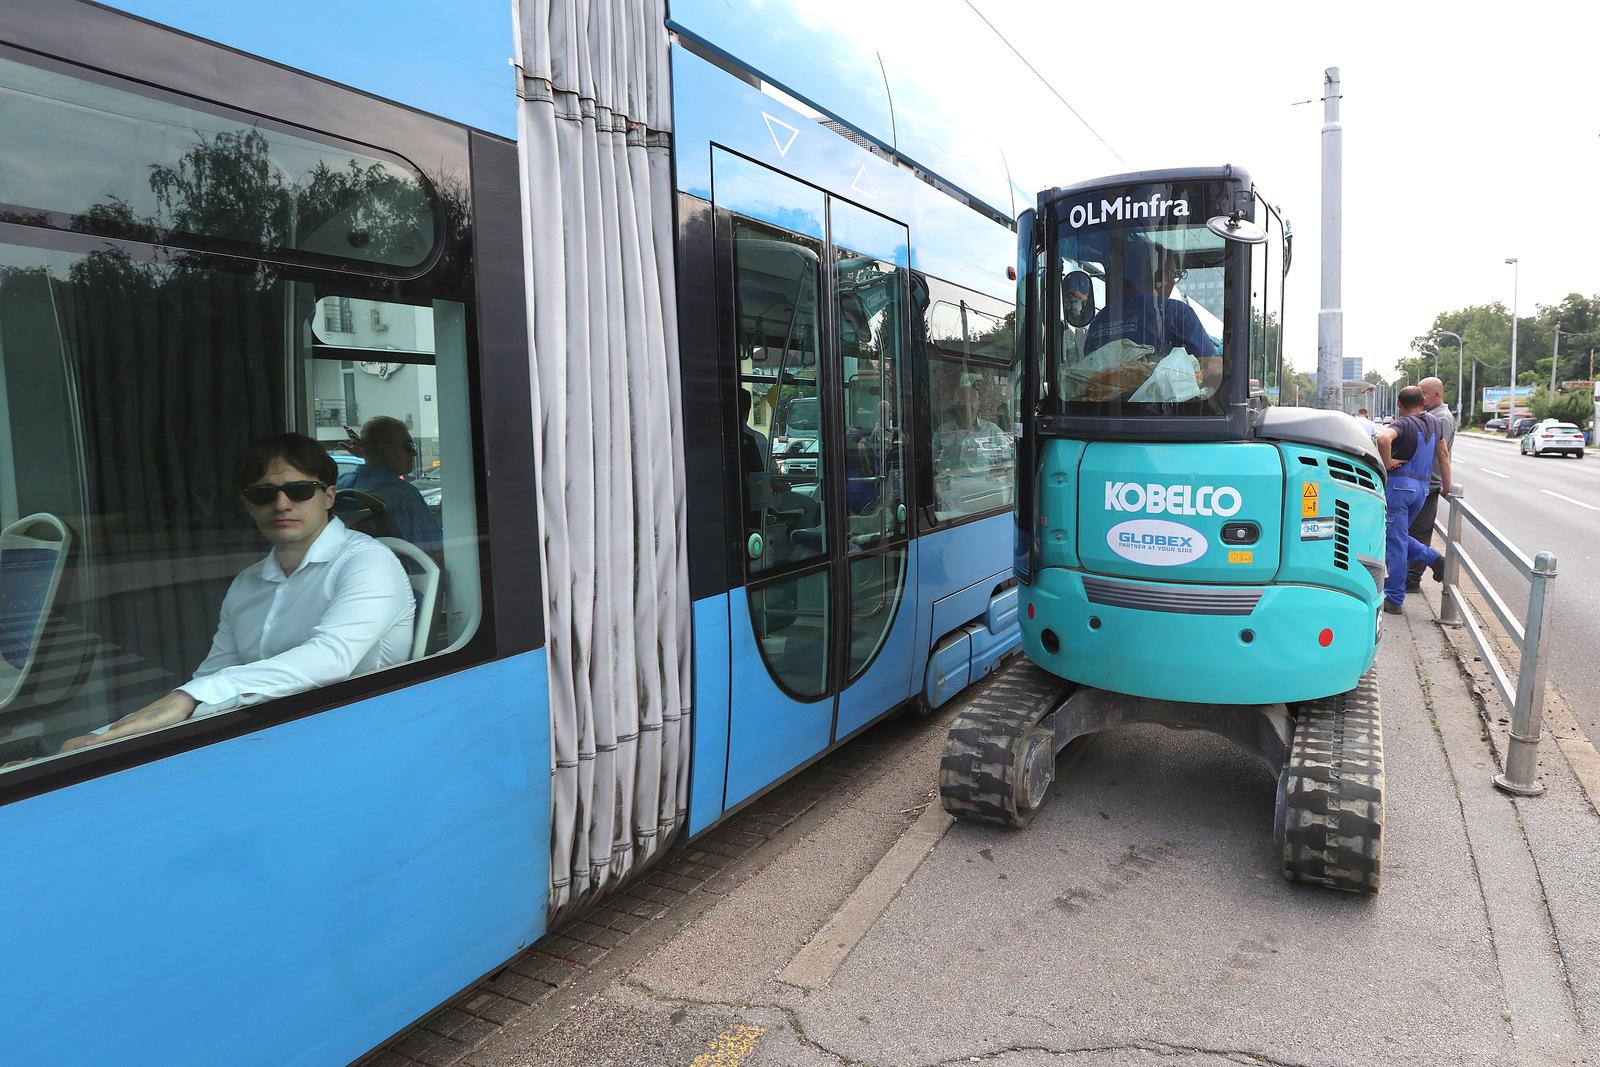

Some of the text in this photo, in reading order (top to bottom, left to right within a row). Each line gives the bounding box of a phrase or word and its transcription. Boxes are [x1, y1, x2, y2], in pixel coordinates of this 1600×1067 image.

[1069, 193, 1190, 229] OLMinfra
[1104, 481, 1242, 517] KOBELCO
[1118, 532, 1193, 548] GLOBEX
[1118, 542, 1146, 550] PARTNER
